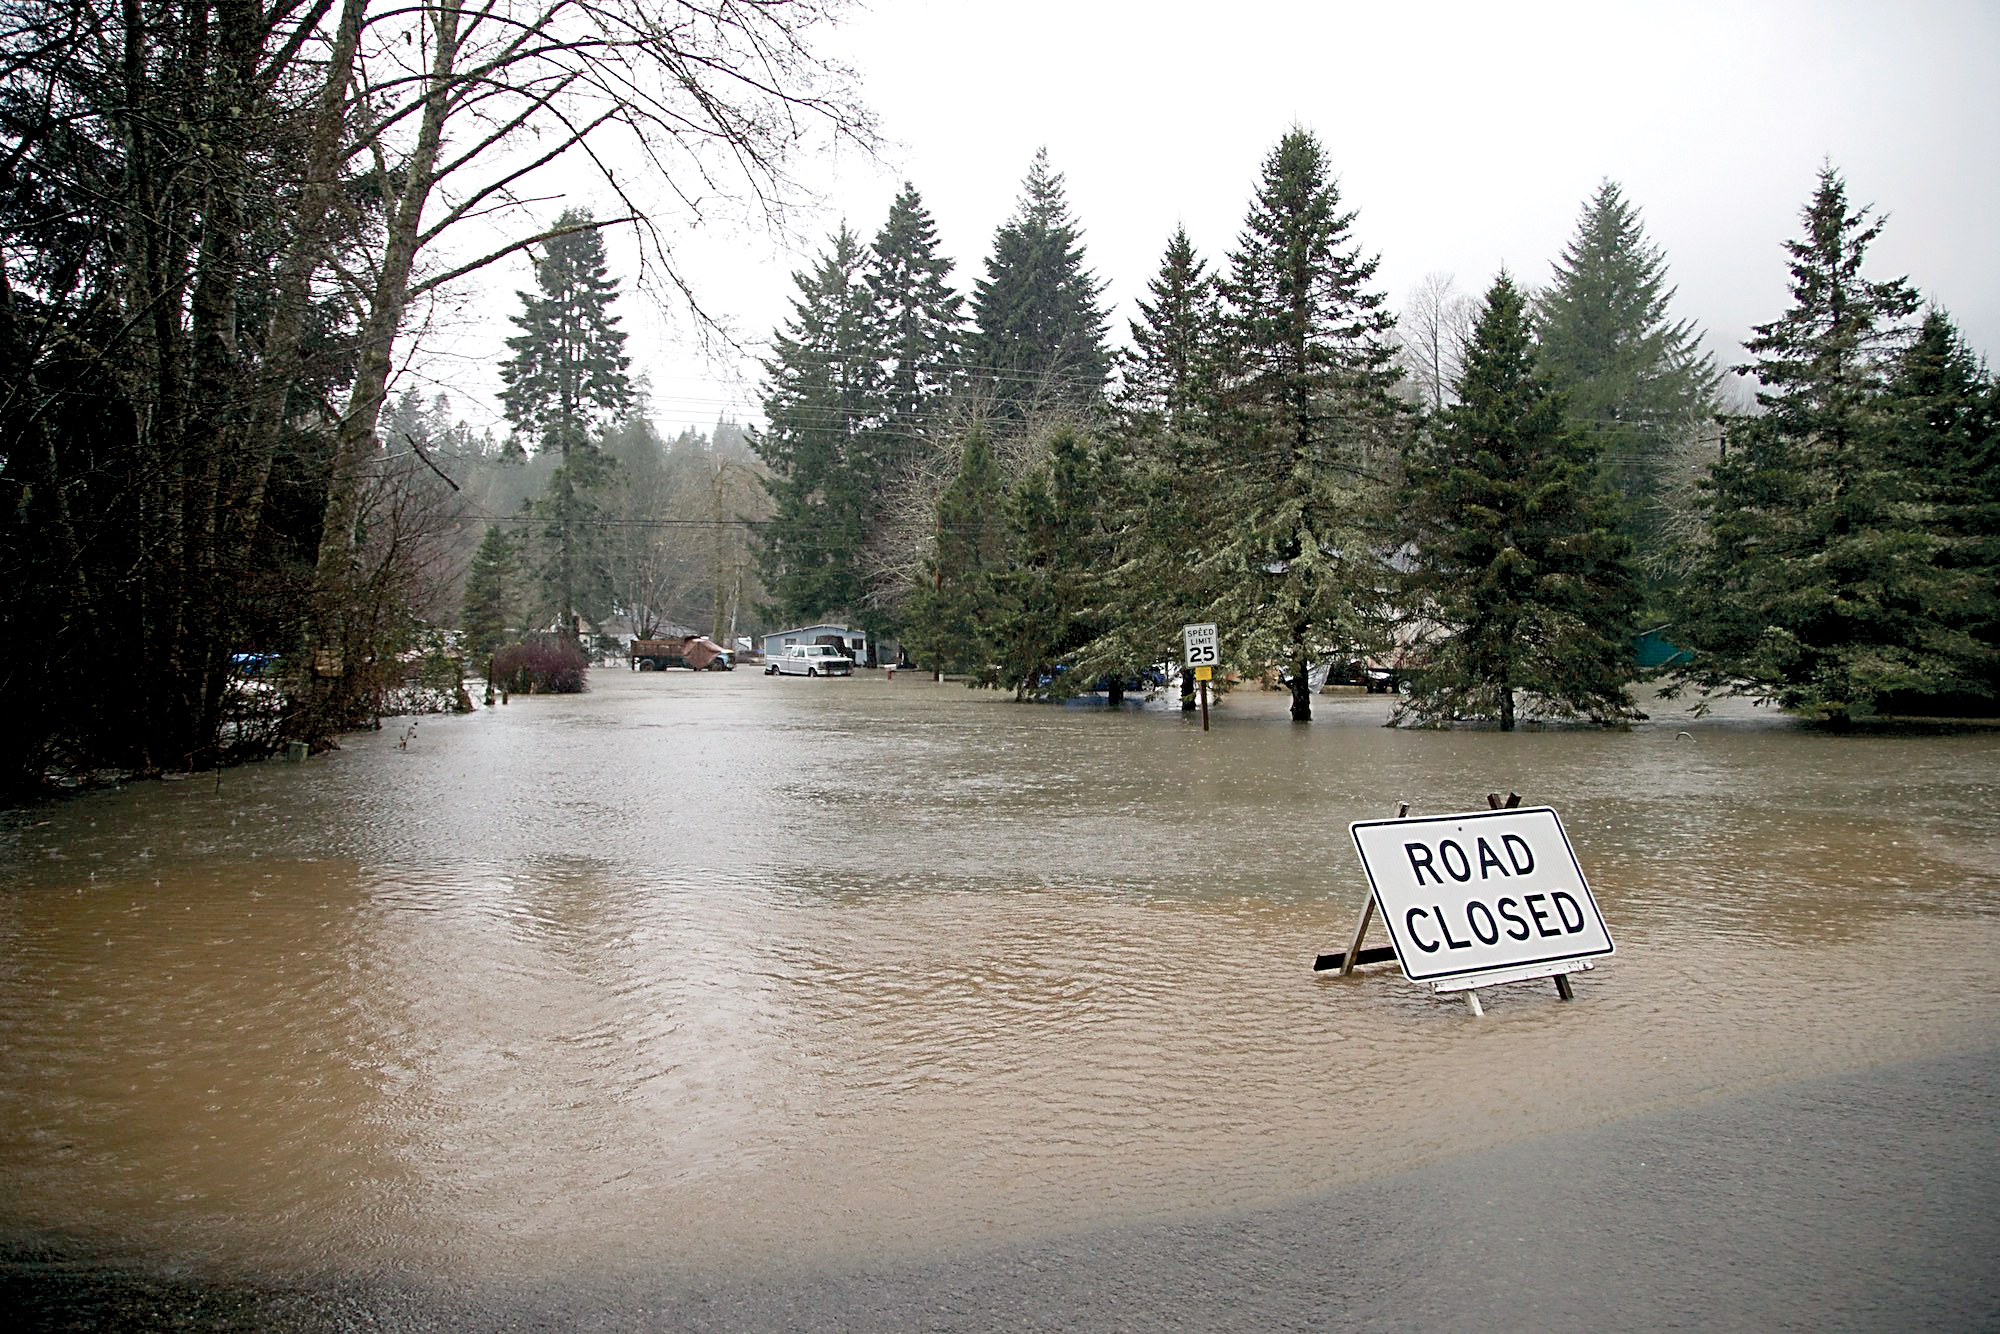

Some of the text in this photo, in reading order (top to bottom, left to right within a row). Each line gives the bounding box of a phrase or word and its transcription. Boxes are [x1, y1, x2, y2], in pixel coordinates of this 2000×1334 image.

[1187, 628, 1214, 637] SPEED
[1189, 646, 1214, 662] 25
[1404, 834, 1535, 886] ROAD
[1405, 891, 1585, 953] CLOSED
